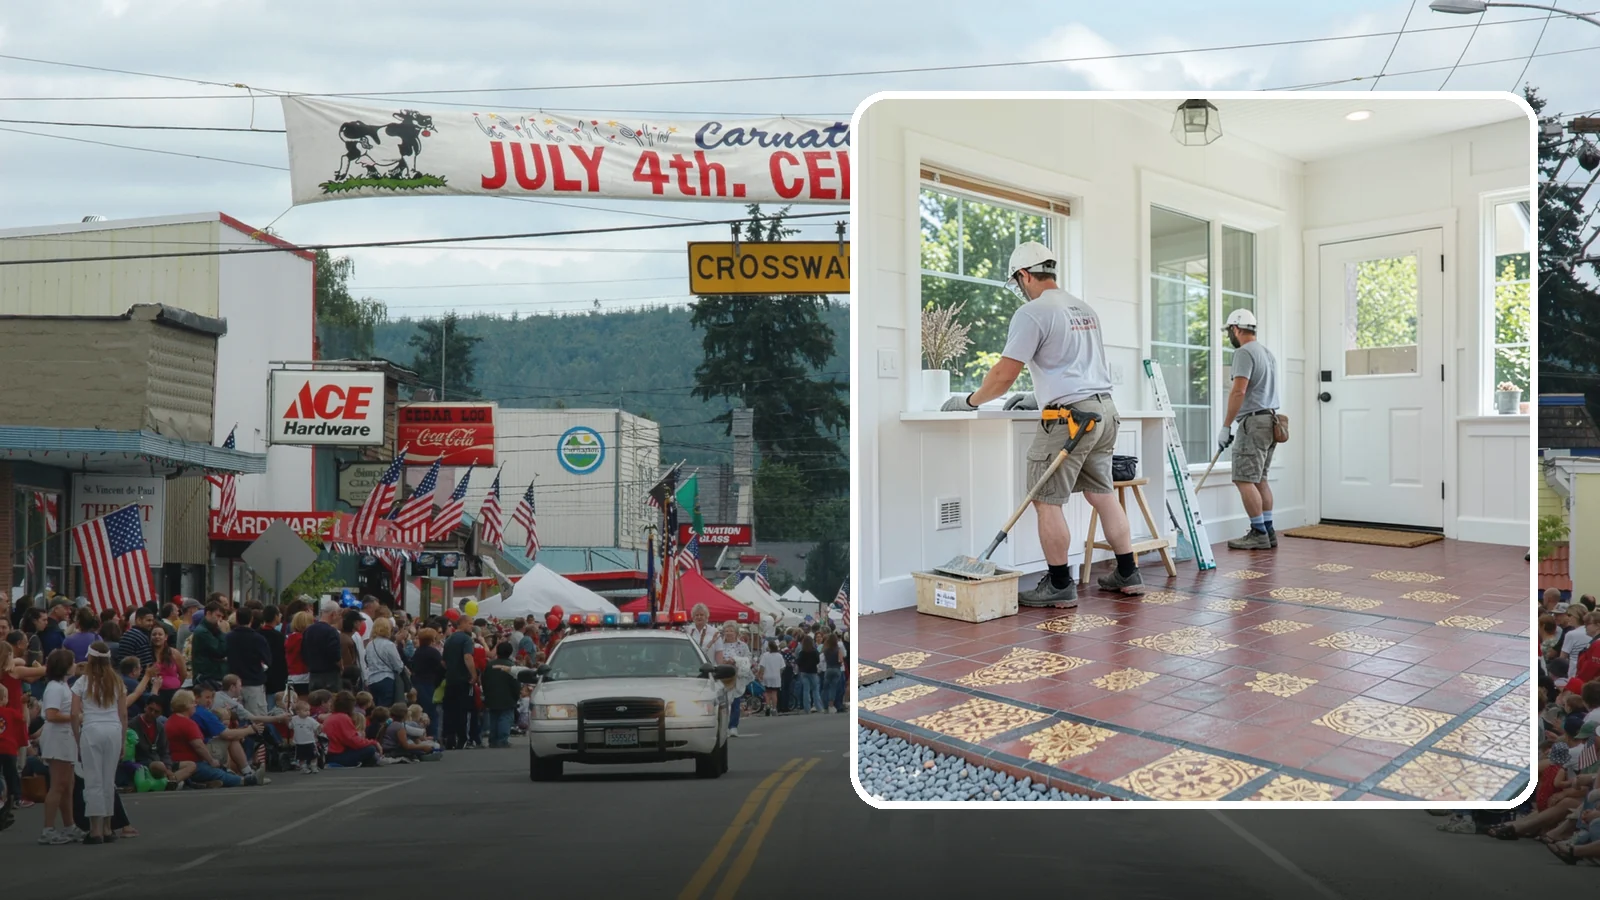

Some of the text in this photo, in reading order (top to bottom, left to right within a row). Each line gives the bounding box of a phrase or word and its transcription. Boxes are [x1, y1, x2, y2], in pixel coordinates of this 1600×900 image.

[481, 141, 605, 192] JULY
[632, 150, 746, 198] 4th.
[696, 253, 850, 280] CROSSWA
[283, 380, 373, 420] ACE
[405, 409, 452, 421] CEDAR
[283, 421, 371, 436] Hardware
[416, 427, 477, 447] Coca-Cola
[354, 466, 385, 480] Simpl
[83, 484, 155, 495] St. Vincent de Paul
[212, 516, 331, 535] HARDARE
[688, 526, 741, 535] CRNATION
[699, 535, 730, 543] GLASS
